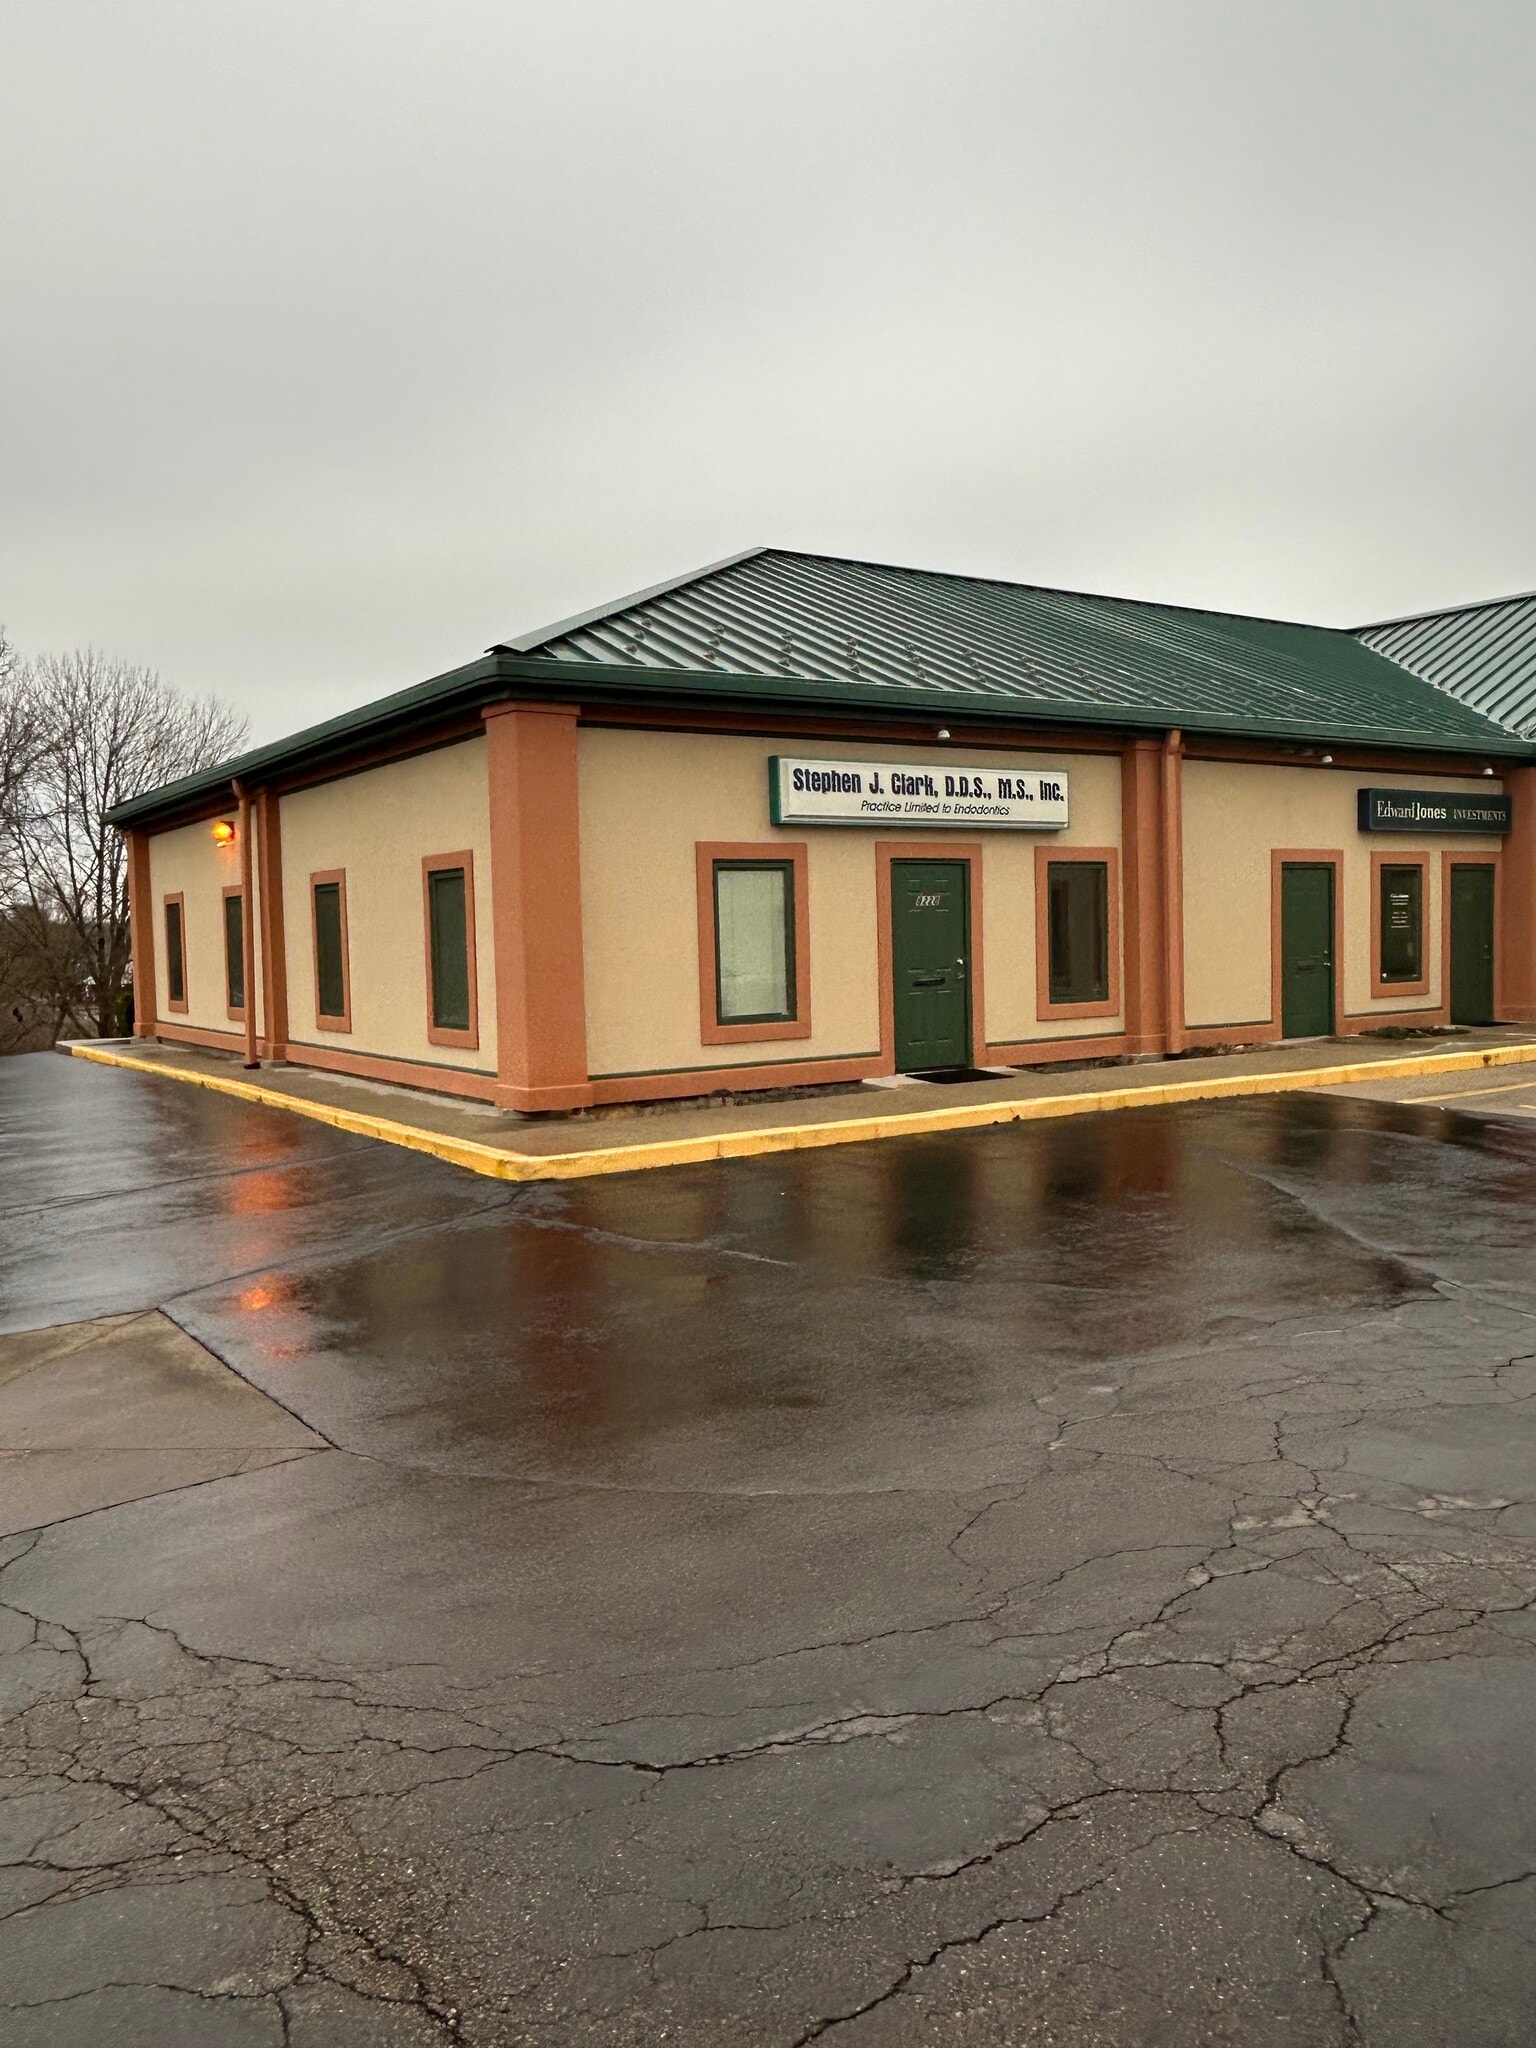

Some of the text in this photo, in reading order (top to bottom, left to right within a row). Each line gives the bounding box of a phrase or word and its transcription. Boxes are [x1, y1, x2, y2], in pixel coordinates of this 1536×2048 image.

[793, 767, 1066, 802] Stephen J. Clark, D.D.S., M.S., Inc.
[860, 799, 1011, 816] Practice Limited to Endodontics
[1453, 808, 1507, 821] INVESTMENTS
